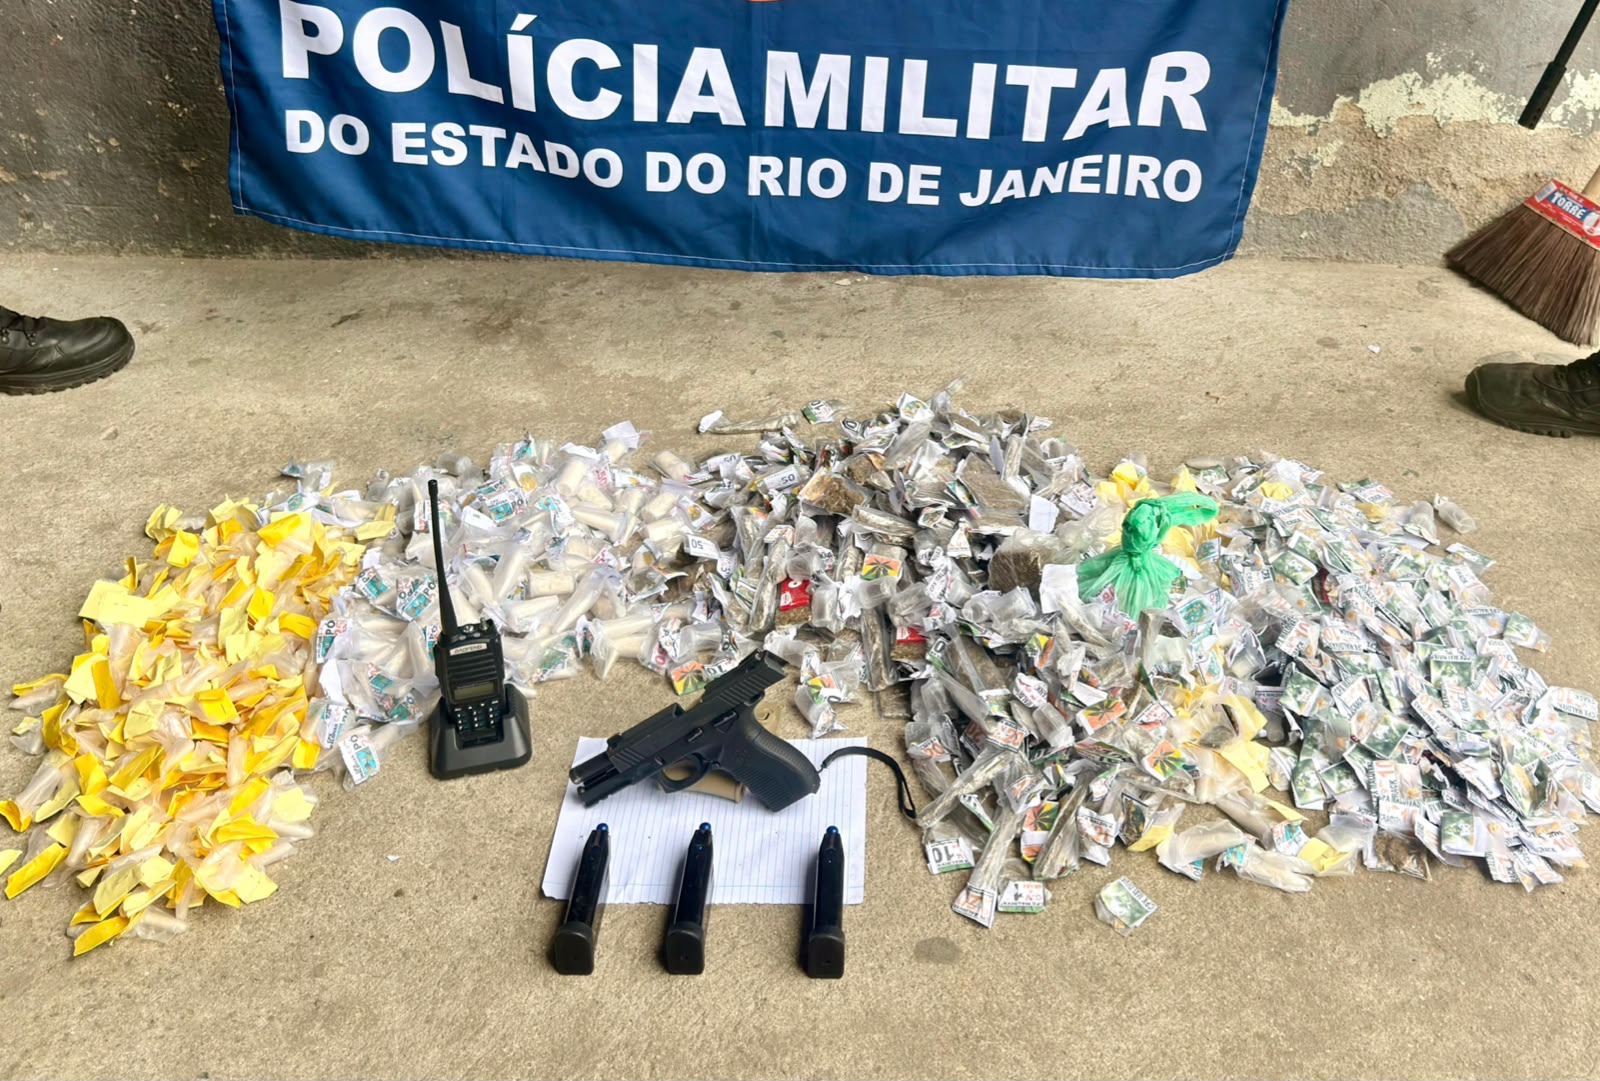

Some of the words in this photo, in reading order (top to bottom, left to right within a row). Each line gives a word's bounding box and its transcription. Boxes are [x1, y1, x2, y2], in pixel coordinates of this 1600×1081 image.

[280, 0, 745, 126] POLÍCIA
[764, 50, 1211, 143] MILITAR
[285, 109, 370, 156] DO
[391, 121, 623, 188] ESTADO
[646, 151, 726, 195] DO
[748, 155, 847, 199] RIO
[867, 162, 942, 207] DE
[959, 154, 1202, 208] JANEIRO
[1551, 191, 1586, 219] TORRE
[781, 473, 795, 485] 50
[932, 844, 954, 863] 10
